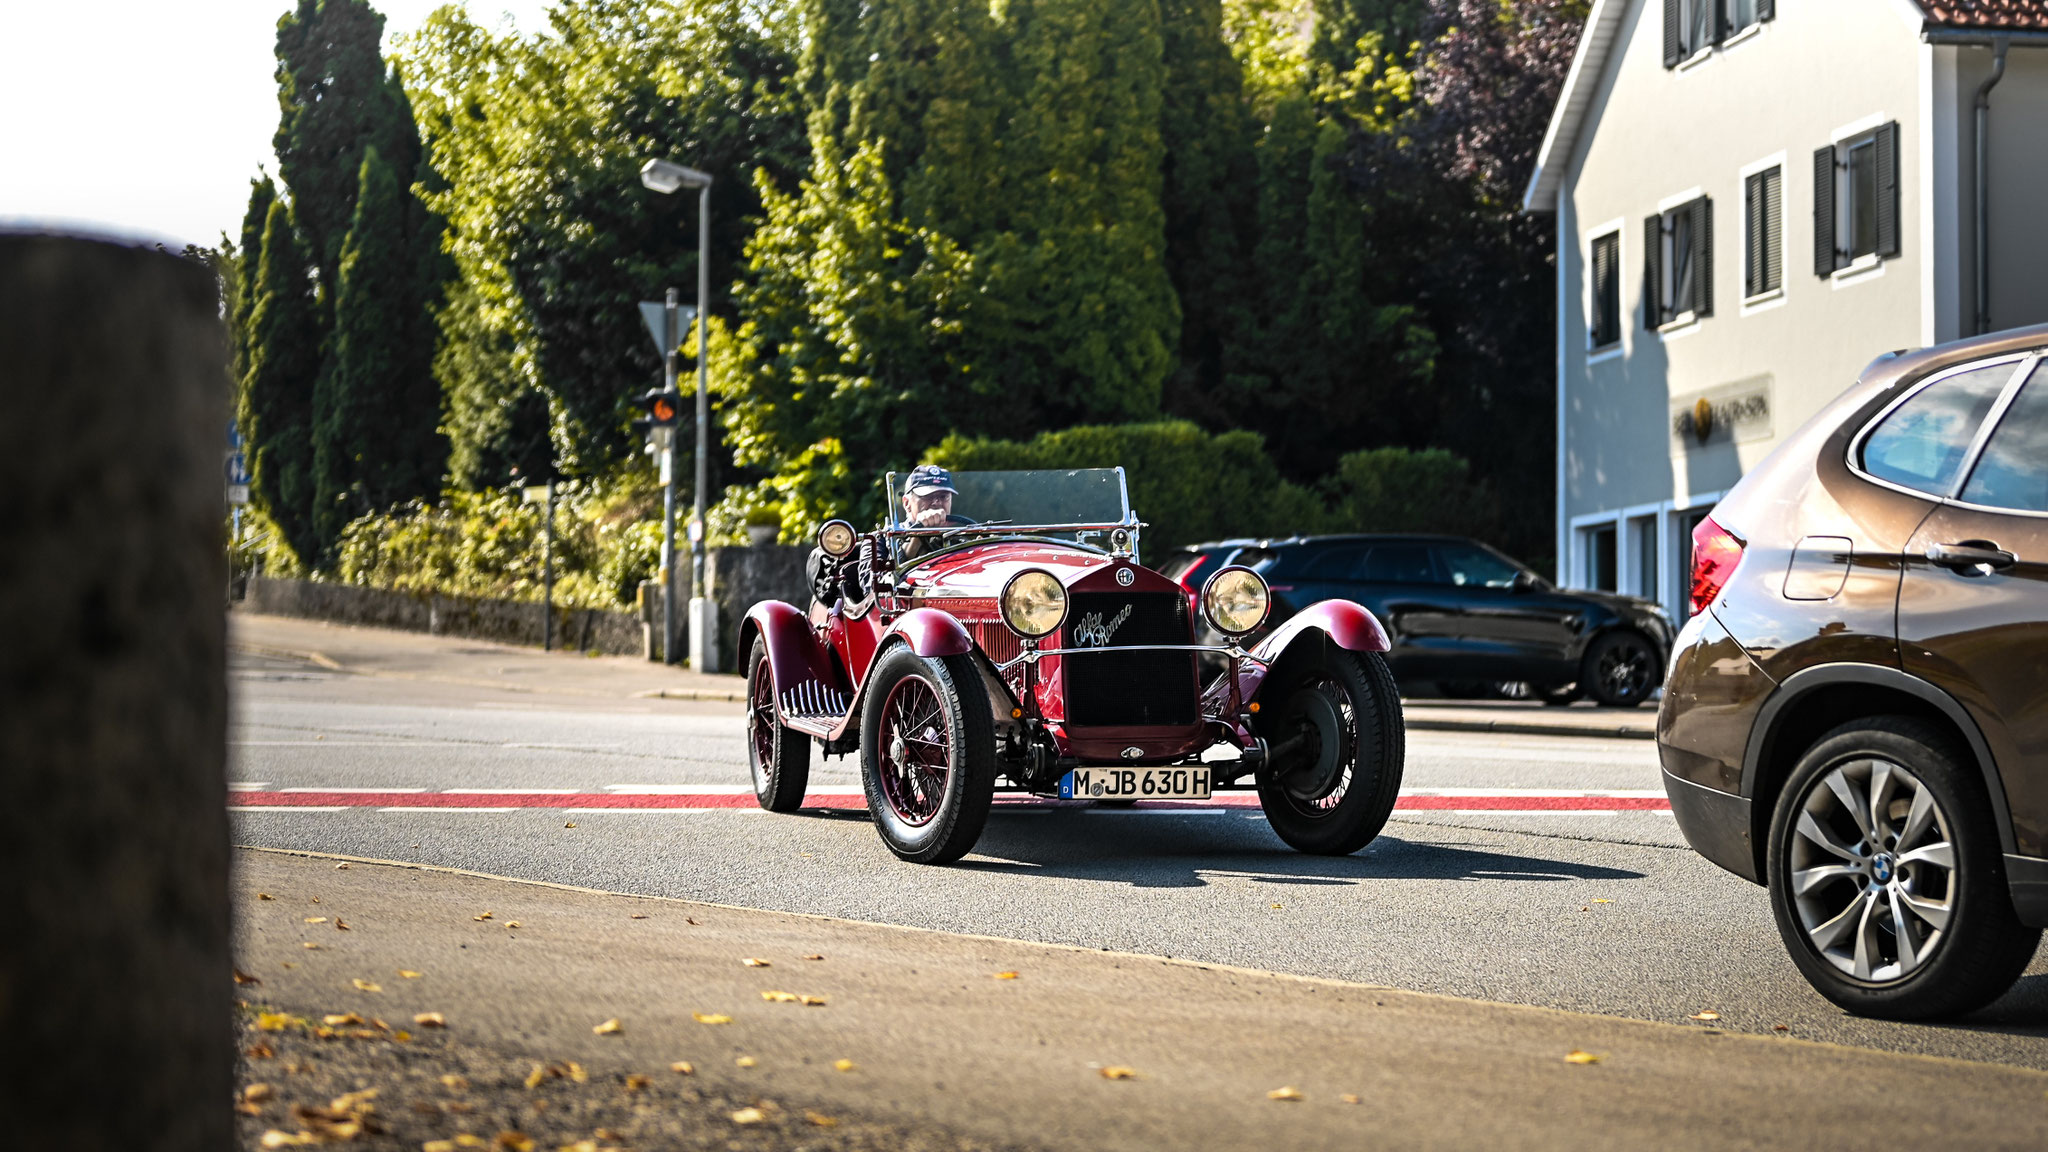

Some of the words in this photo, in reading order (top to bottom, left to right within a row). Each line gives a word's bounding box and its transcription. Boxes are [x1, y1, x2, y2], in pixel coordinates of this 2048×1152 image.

[1074, 612, 1103, 647] Alfa
[1092, 604, 1133, 647] Romeo
[1062, 786, 1069, 794] D
[1073, 770, 1090, 795] M
